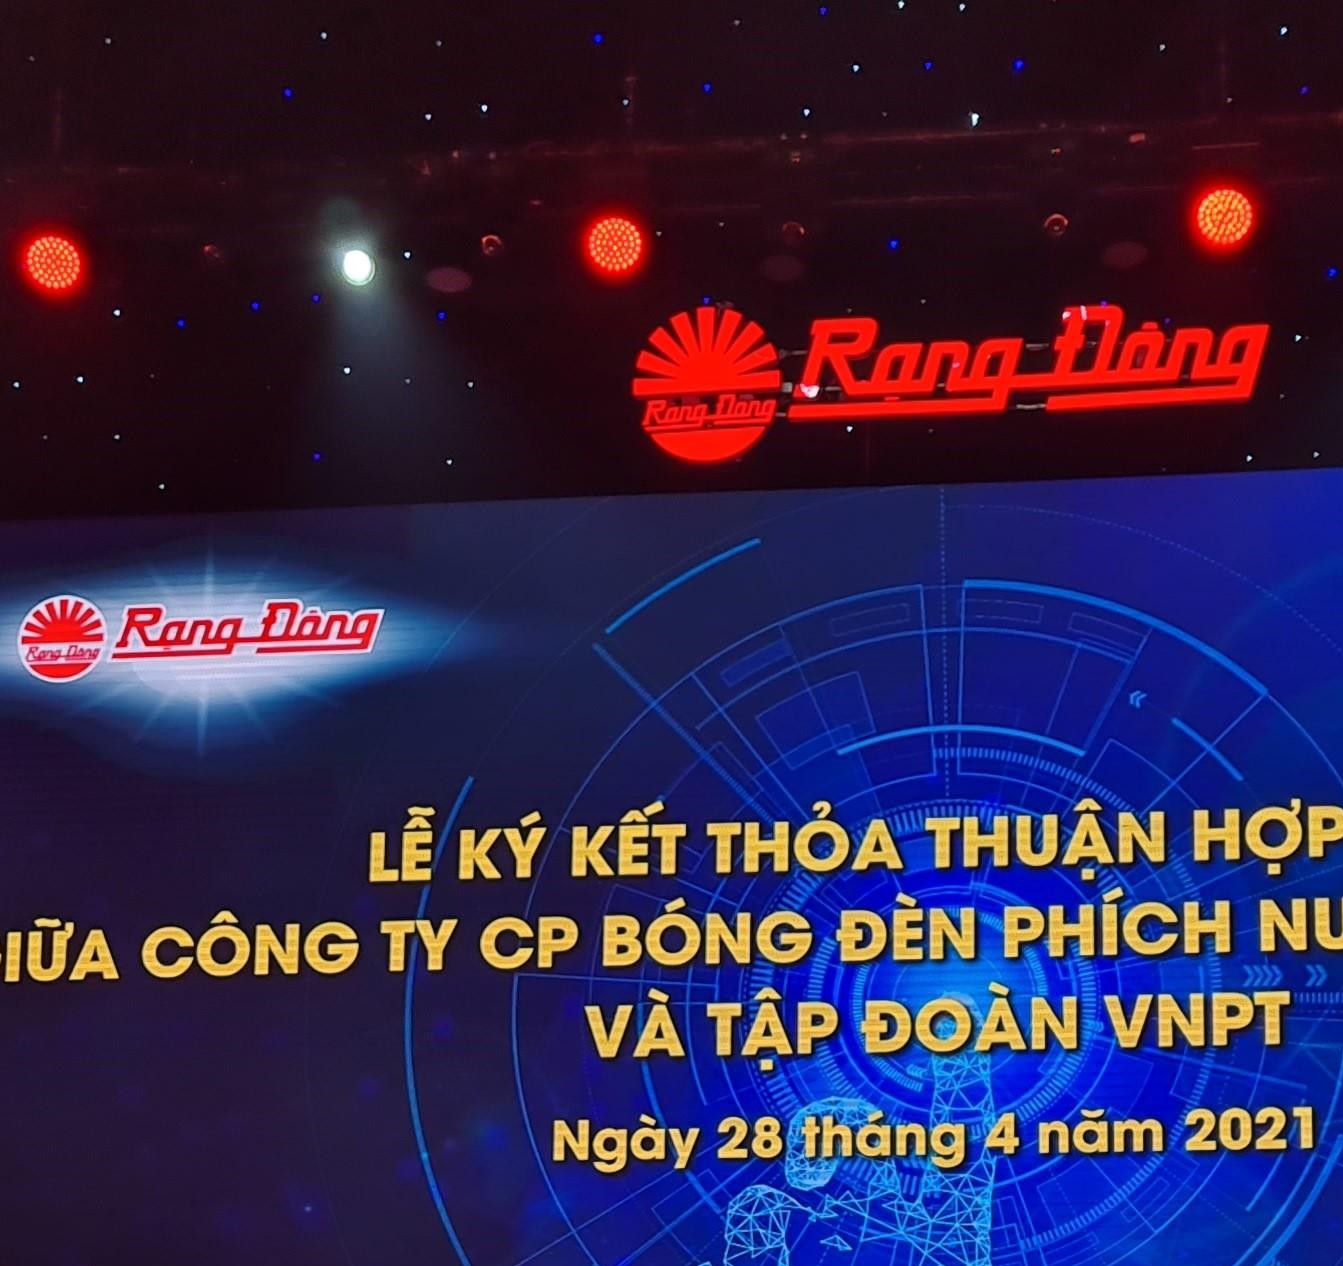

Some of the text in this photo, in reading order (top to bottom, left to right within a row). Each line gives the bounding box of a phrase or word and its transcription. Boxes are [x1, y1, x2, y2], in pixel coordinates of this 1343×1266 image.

[370, 807, 434, 881] LỄ
[460, 813, 545, 879] KÝ
[572, 804, 686, 876] KẾT
[708, 803, 902, 872] THỎA
[927, 800, 1164, 879] THUẬN
[142, 912, 358, 977] CÔNG
[381, 920, 457, 971] TY
[481, 917, 578, 968] CP
[603, 900, 811, 966] BÓNG
[838, 897, 974, 961] ĐÈN
[1006, 890, 1230, 957] PHÍCH
[587, 986, 1289, 1070] VÀ TẬP ĐOÀN VNPT
[554, 1109, 1312, 1172] Ngày 28 tháng 4 năm 2021
